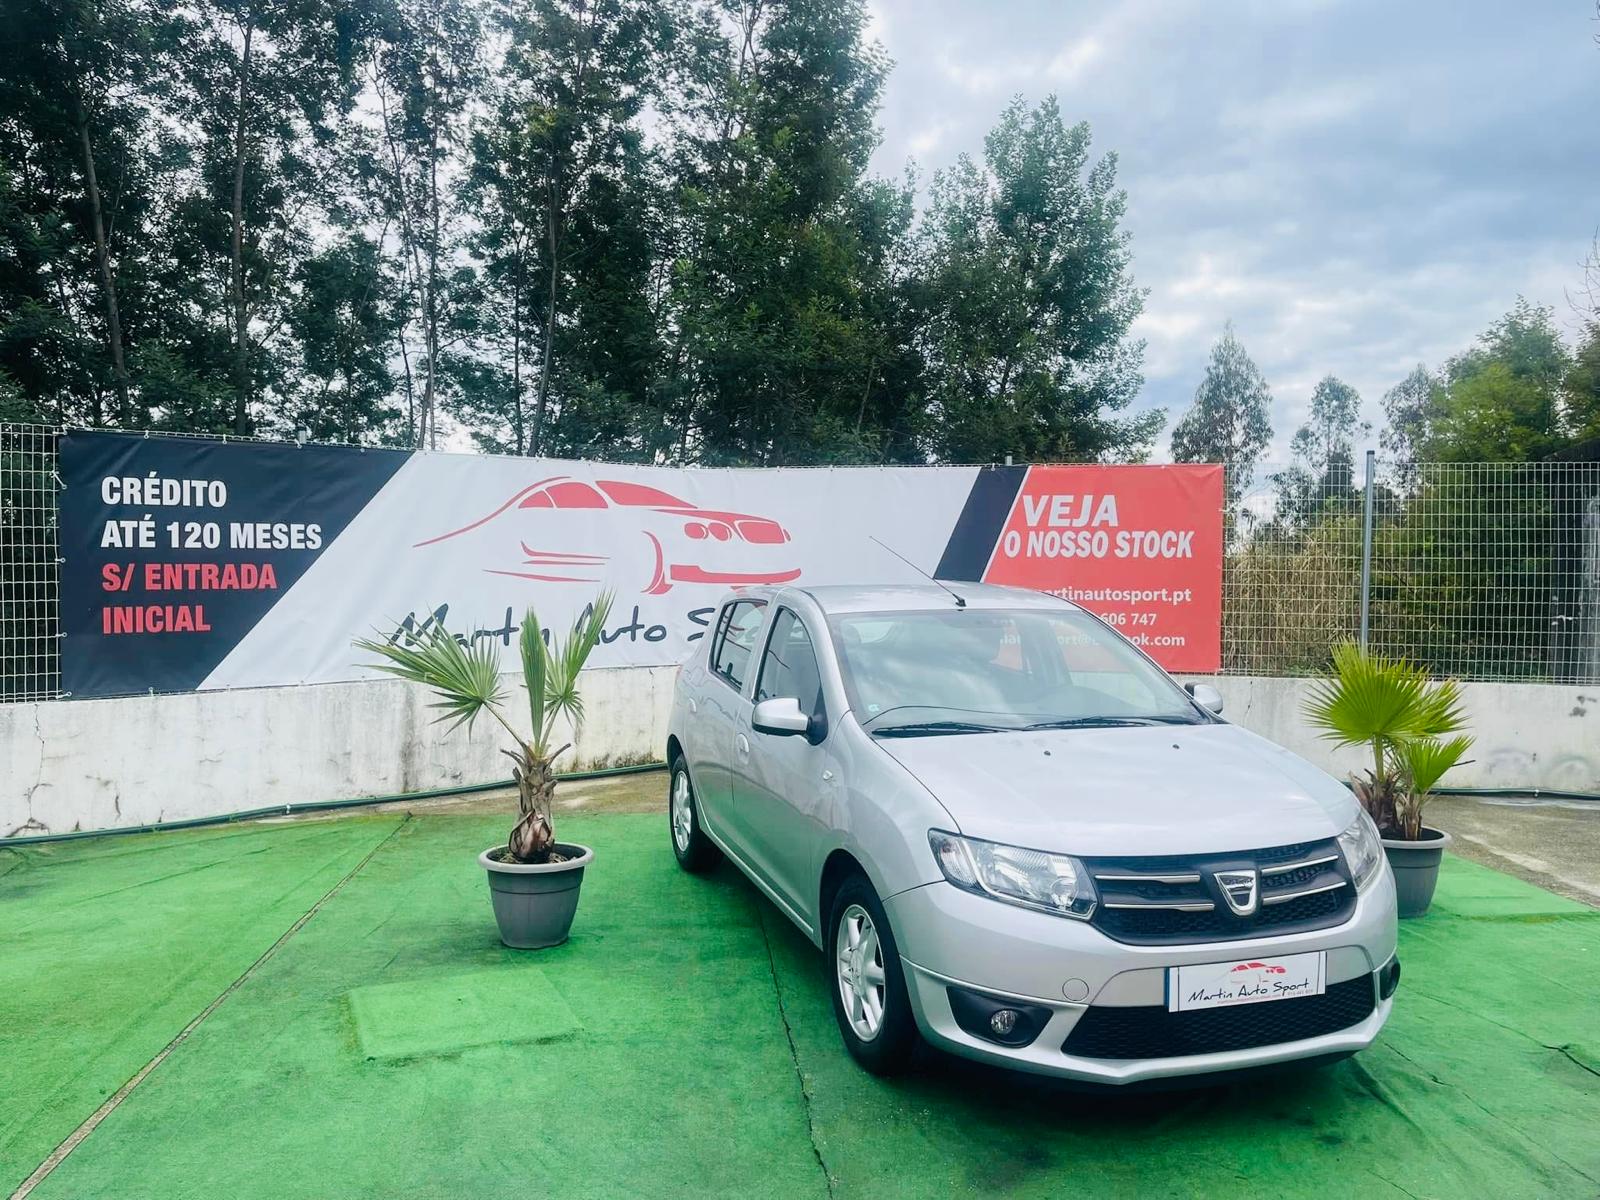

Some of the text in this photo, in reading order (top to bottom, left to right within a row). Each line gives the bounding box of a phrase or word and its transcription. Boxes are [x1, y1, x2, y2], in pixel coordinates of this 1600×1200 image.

[101, 471, 227, 507] CRÉDITO
[1022, 494, 1118, 527] VEJA
[101, 514, 322, 550] ATÉ 120 MESES
[1004, 530, 1195, 558] O NOSSO STOCK
[102, 563, 277, 592] S/ ENTRADA
[102, 605, 211, 634] INICIAL
[1131, 613, 1157, 625] 747
[1188, 988, 1232, 1002] Martin
[1237, 984, 1268, 997] Auto
[1273, 977, 1309, 997] Sport
